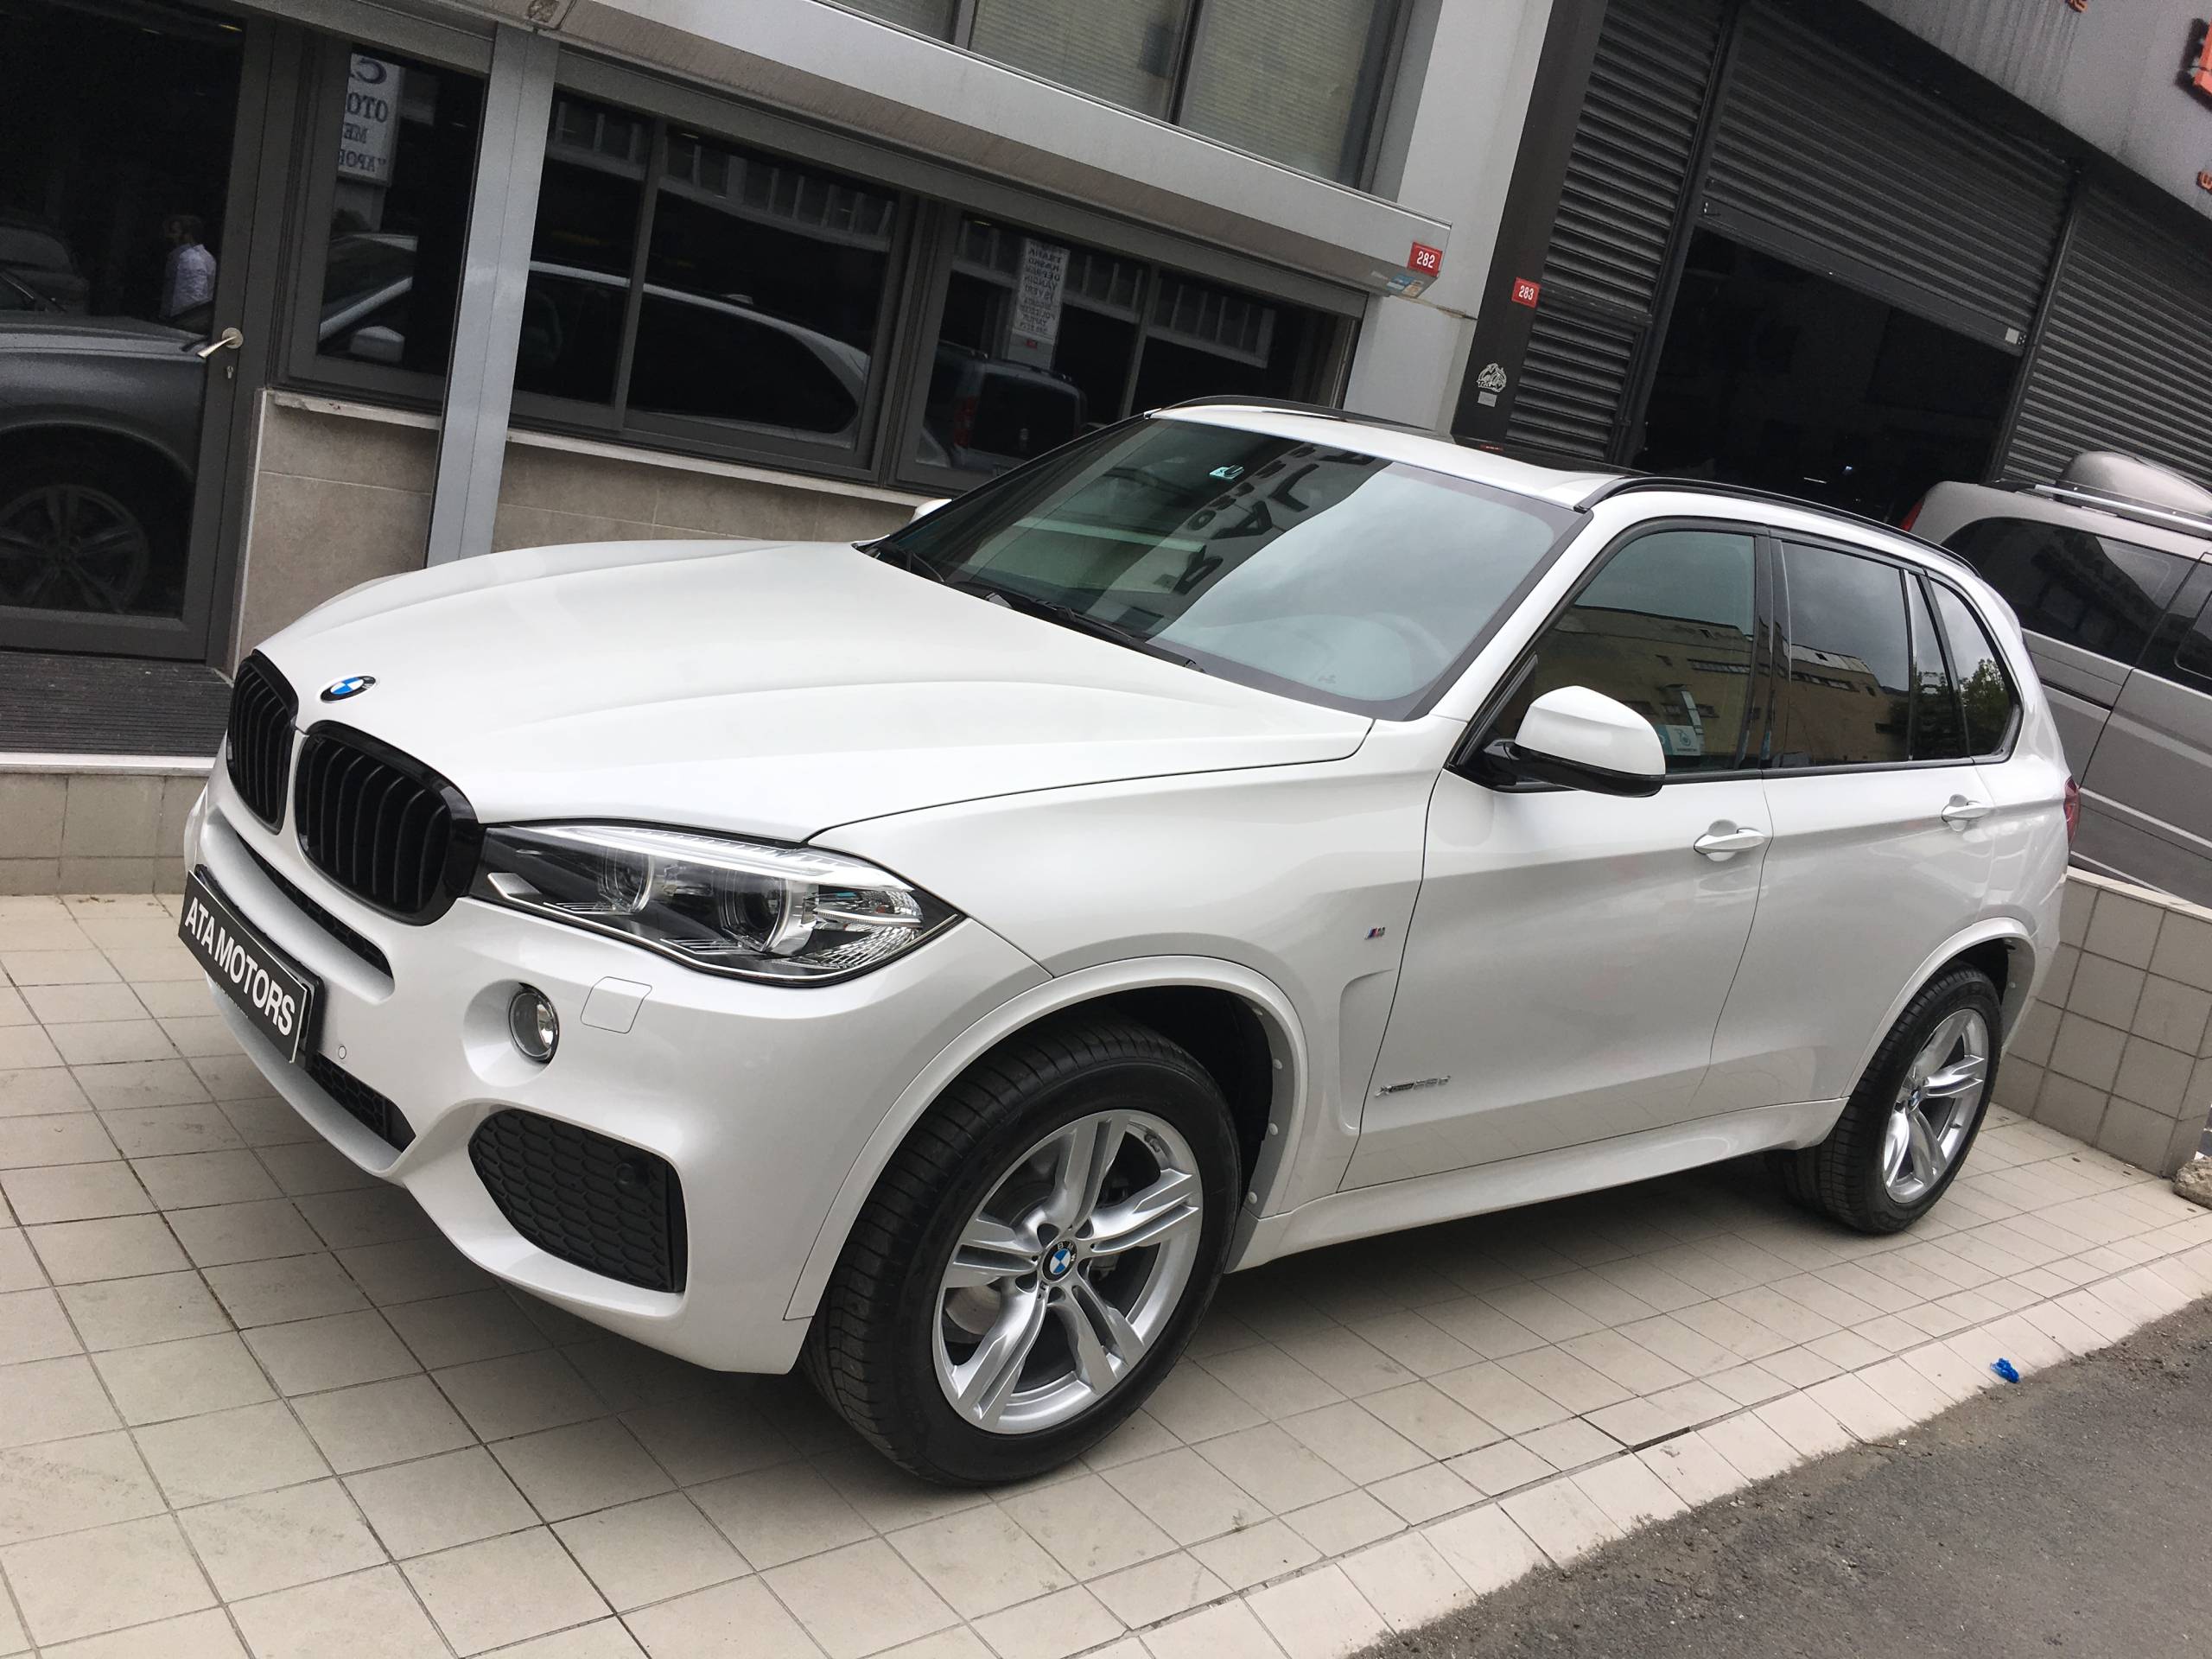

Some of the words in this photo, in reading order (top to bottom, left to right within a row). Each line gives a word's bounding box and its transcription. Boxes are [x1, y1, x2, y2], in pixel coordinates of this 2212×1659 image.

[1416, 251, 1435, 269] 282
[1518, 284, 1535, 301] 283
[184, 897, 215, 954] ATA
[214, 927, 296, 1035] MOTORS
